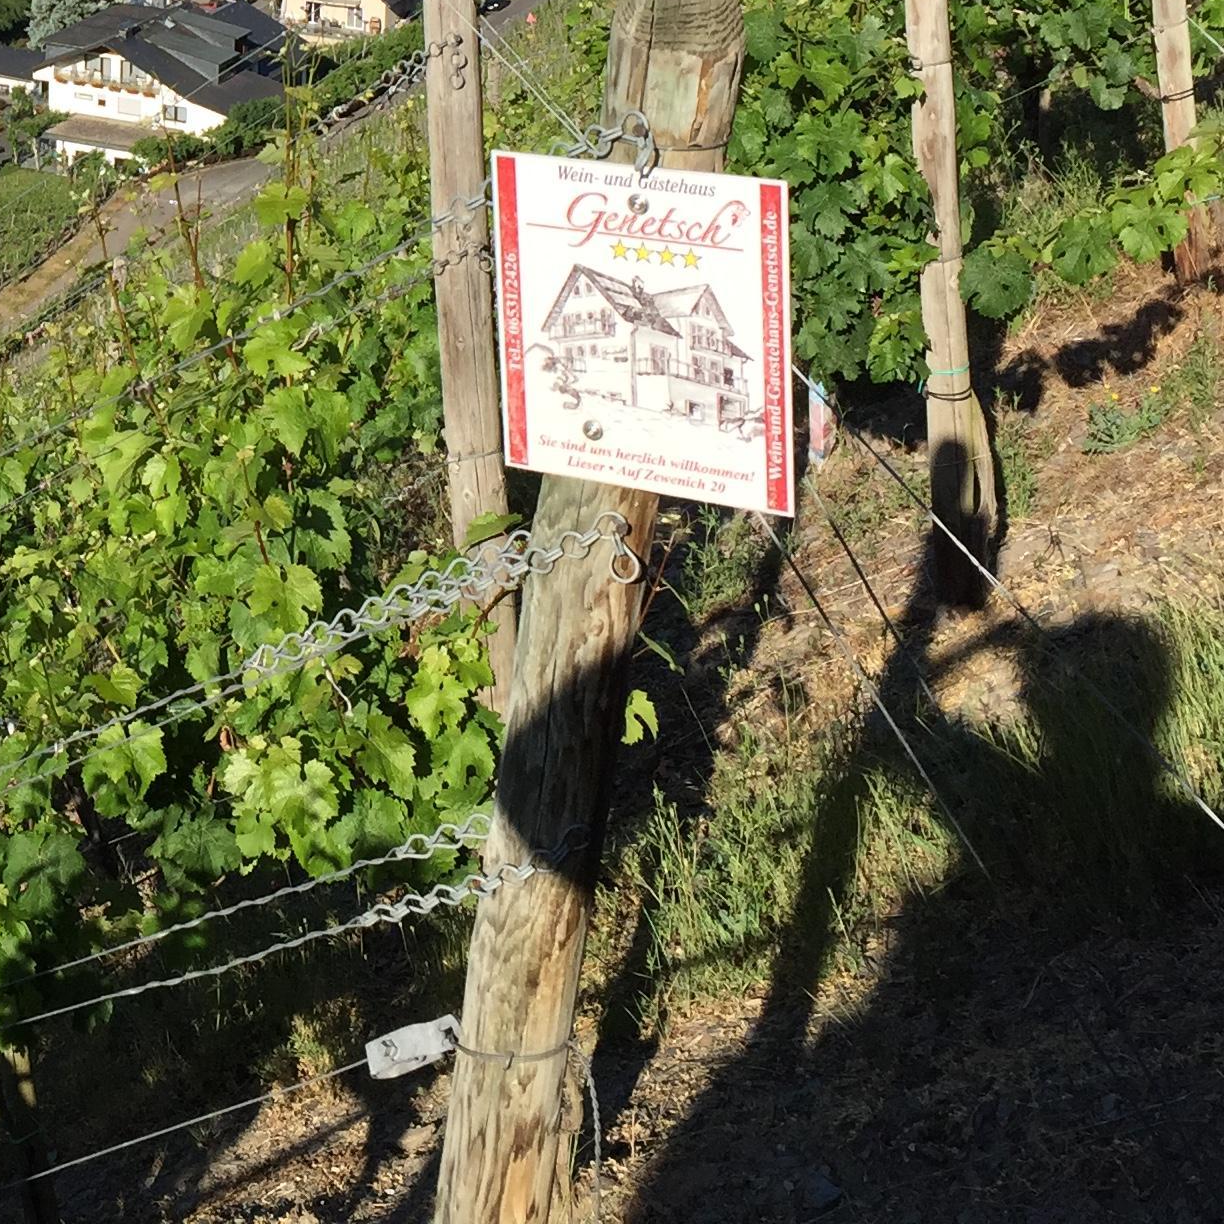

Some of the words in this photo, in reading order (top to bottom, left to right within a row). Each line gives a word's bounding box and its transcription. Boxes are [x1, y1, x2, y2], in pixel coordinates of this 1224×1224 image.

[557, 165, 599, 184] Wein-
[604, 174, 632, 188] und
[637, 174, 716, 197] Gästehaus
[567, 192, 748, 247] Genetsch
[507, 337, 521, 371] Tel.:
[538, 434, 557, 447] Sie
[561, 439, 586, 453] sind
[590, 446, 612, 457] uns
[615, 448, 666, 466] herzlich
[670, 459, 755, 481] willkommen!
[567, 455, 605, 472] Lieser
[617, 466, 642, 480] Auf
[644, 470, 705, 490] Zewenich
[710, 480, 726, 494] 20
